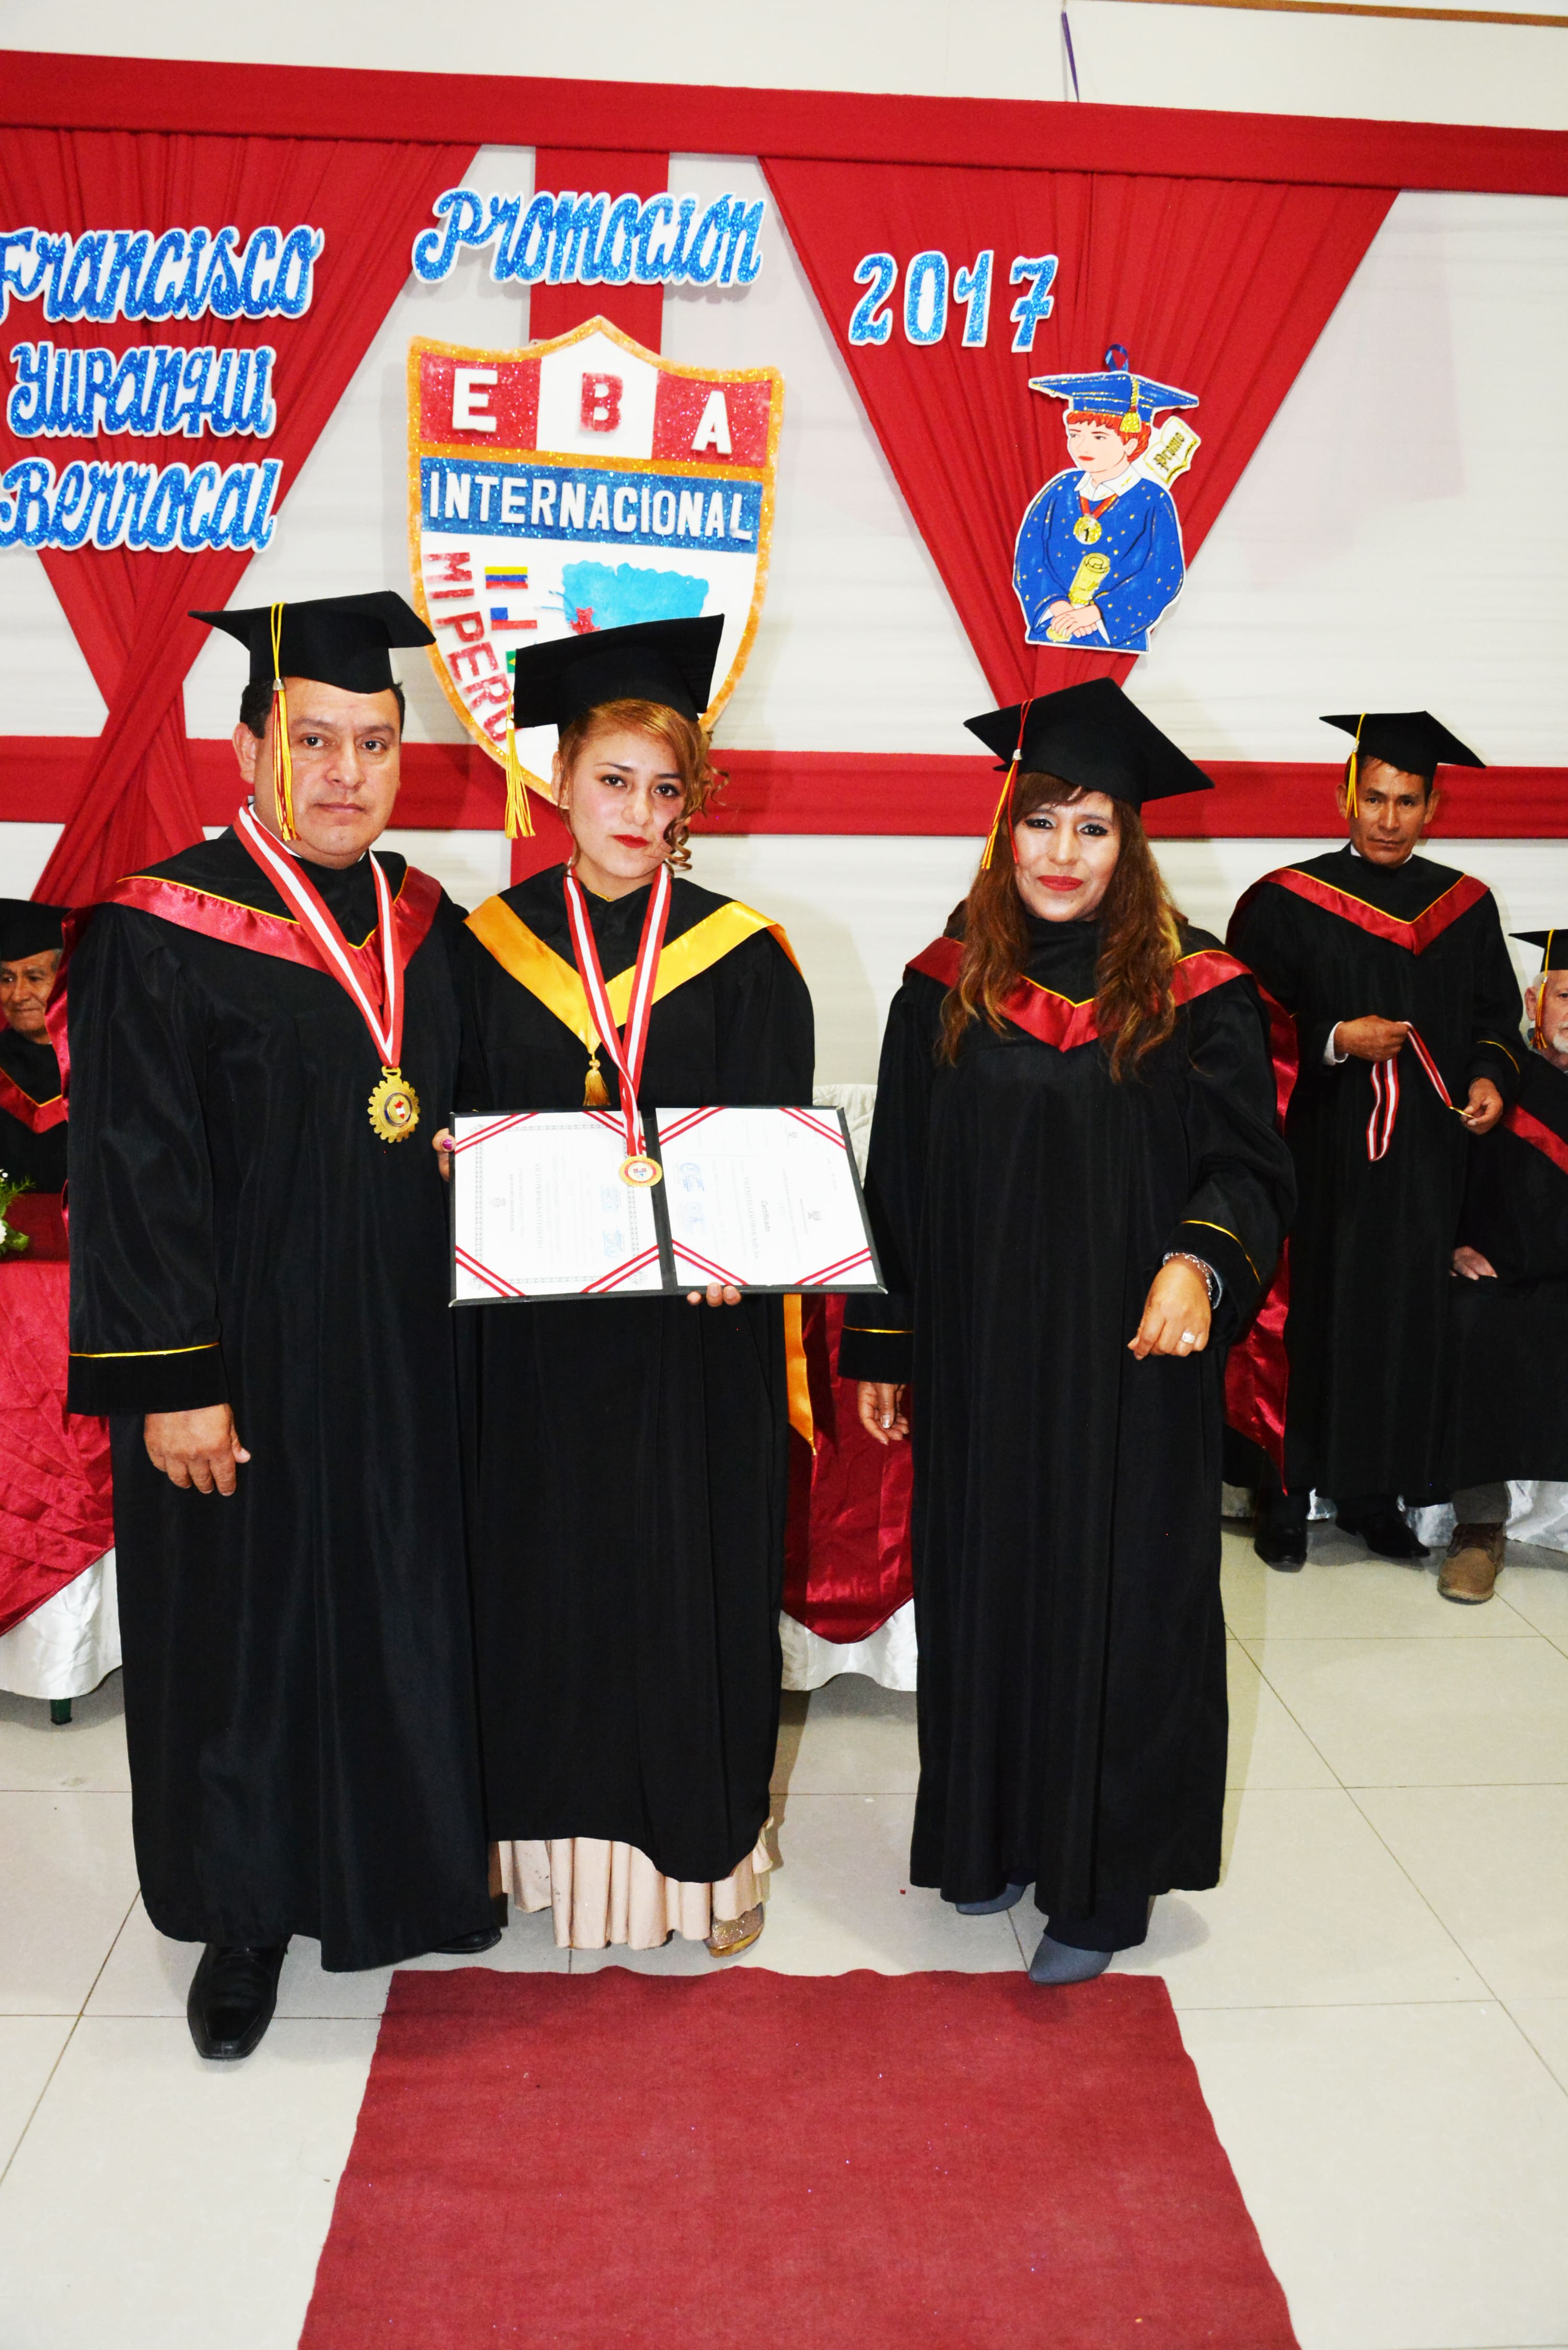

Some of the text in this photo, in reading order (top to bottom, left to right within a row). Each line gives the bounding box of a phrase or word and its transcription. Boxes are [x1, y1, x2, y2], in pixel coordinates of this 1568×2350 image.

[0, 228, 321, 320] Francisco
[849, 252, 1057, 349] 2017
[0, 460, 280, 550] Berrocal
[430, 471, 753, 540] INTERNACIONAL
